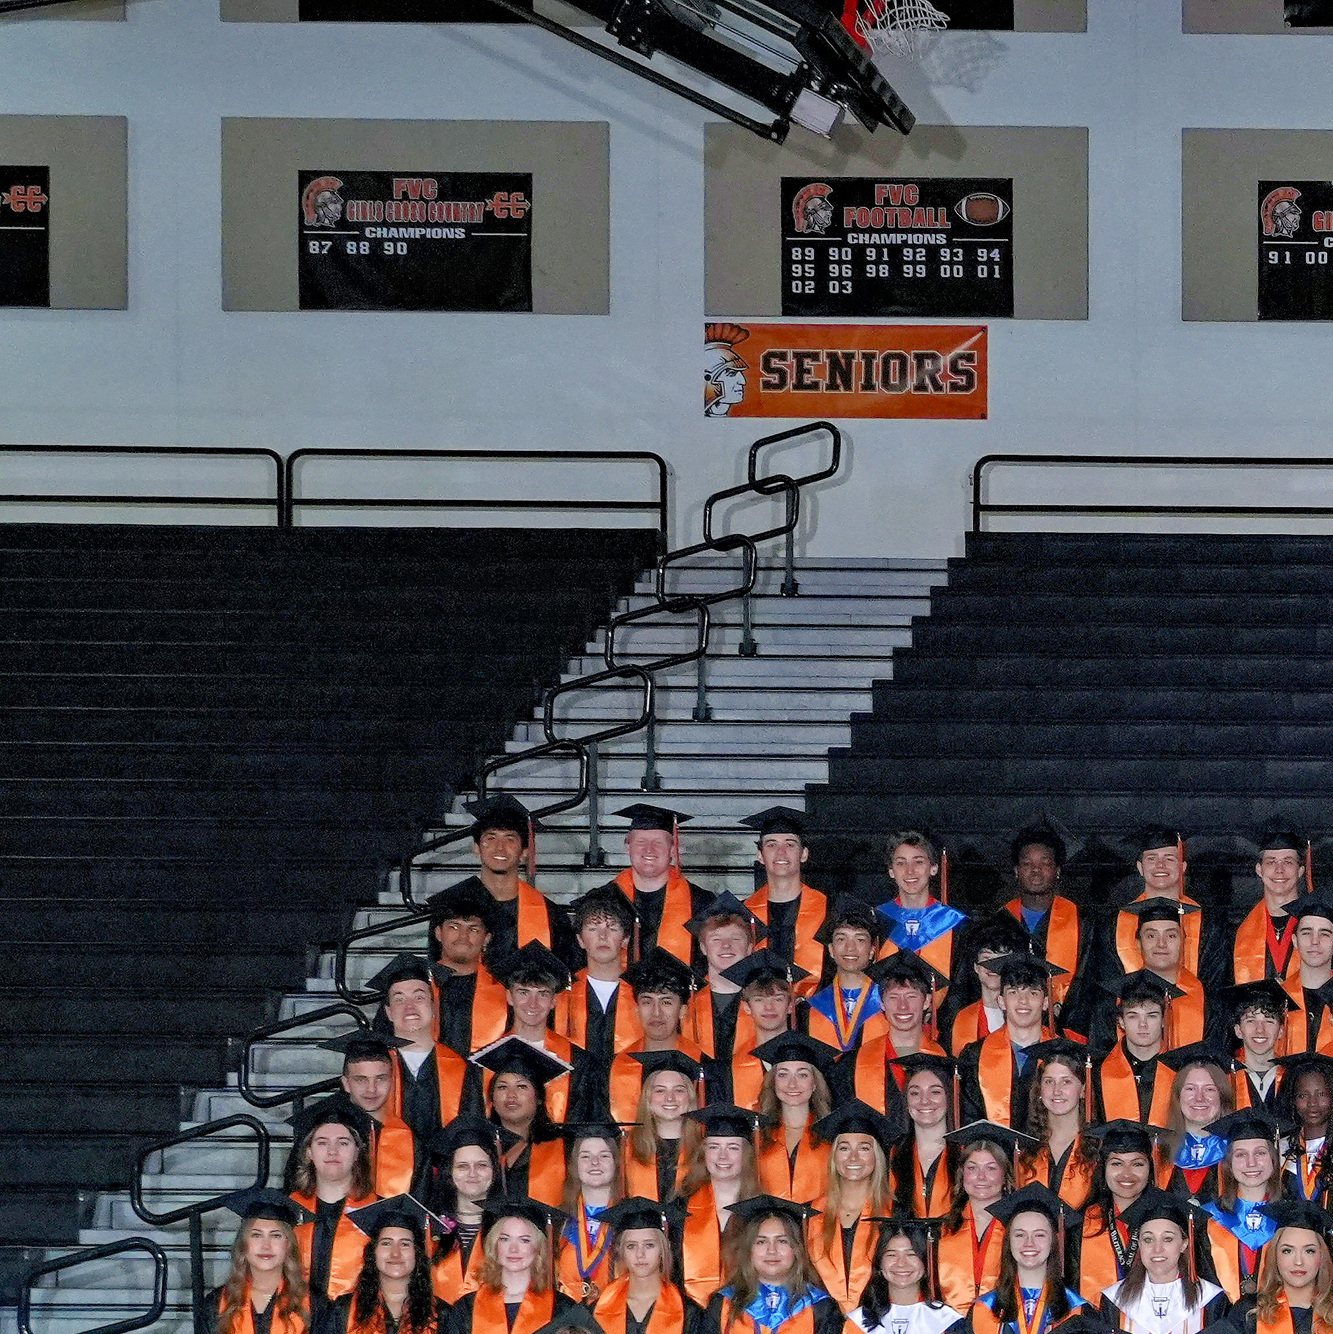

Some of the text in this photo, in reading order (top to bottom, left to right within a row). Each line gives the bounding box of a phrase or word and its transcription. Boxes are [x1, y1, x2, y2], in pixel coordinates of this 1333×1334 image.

[393, 178, 438, 199] FVC
[874, 184, 919, 206] FVC
[347, 200, 484, 223] GIRLS CROSS COUNTRY
[843, 207, 951, 229] FOOTBALL
[365, 227, 465, 239] CHAMPIONS
[847, 233, 947, 245] CHAMPIONS
[309, 241, 408, 255] 87 88 90
[791, 248, 1000, 261] 89 90 91 92 93 94
[1268, 251, 1291, 264] 91
[1306, 251, 1328, 264] 00
[791, 264, 1000, 278] 95 96 98 99 00 01
[791, 281, 851, 294] 02 03
[760, 349, 977, 394] SENIORS
